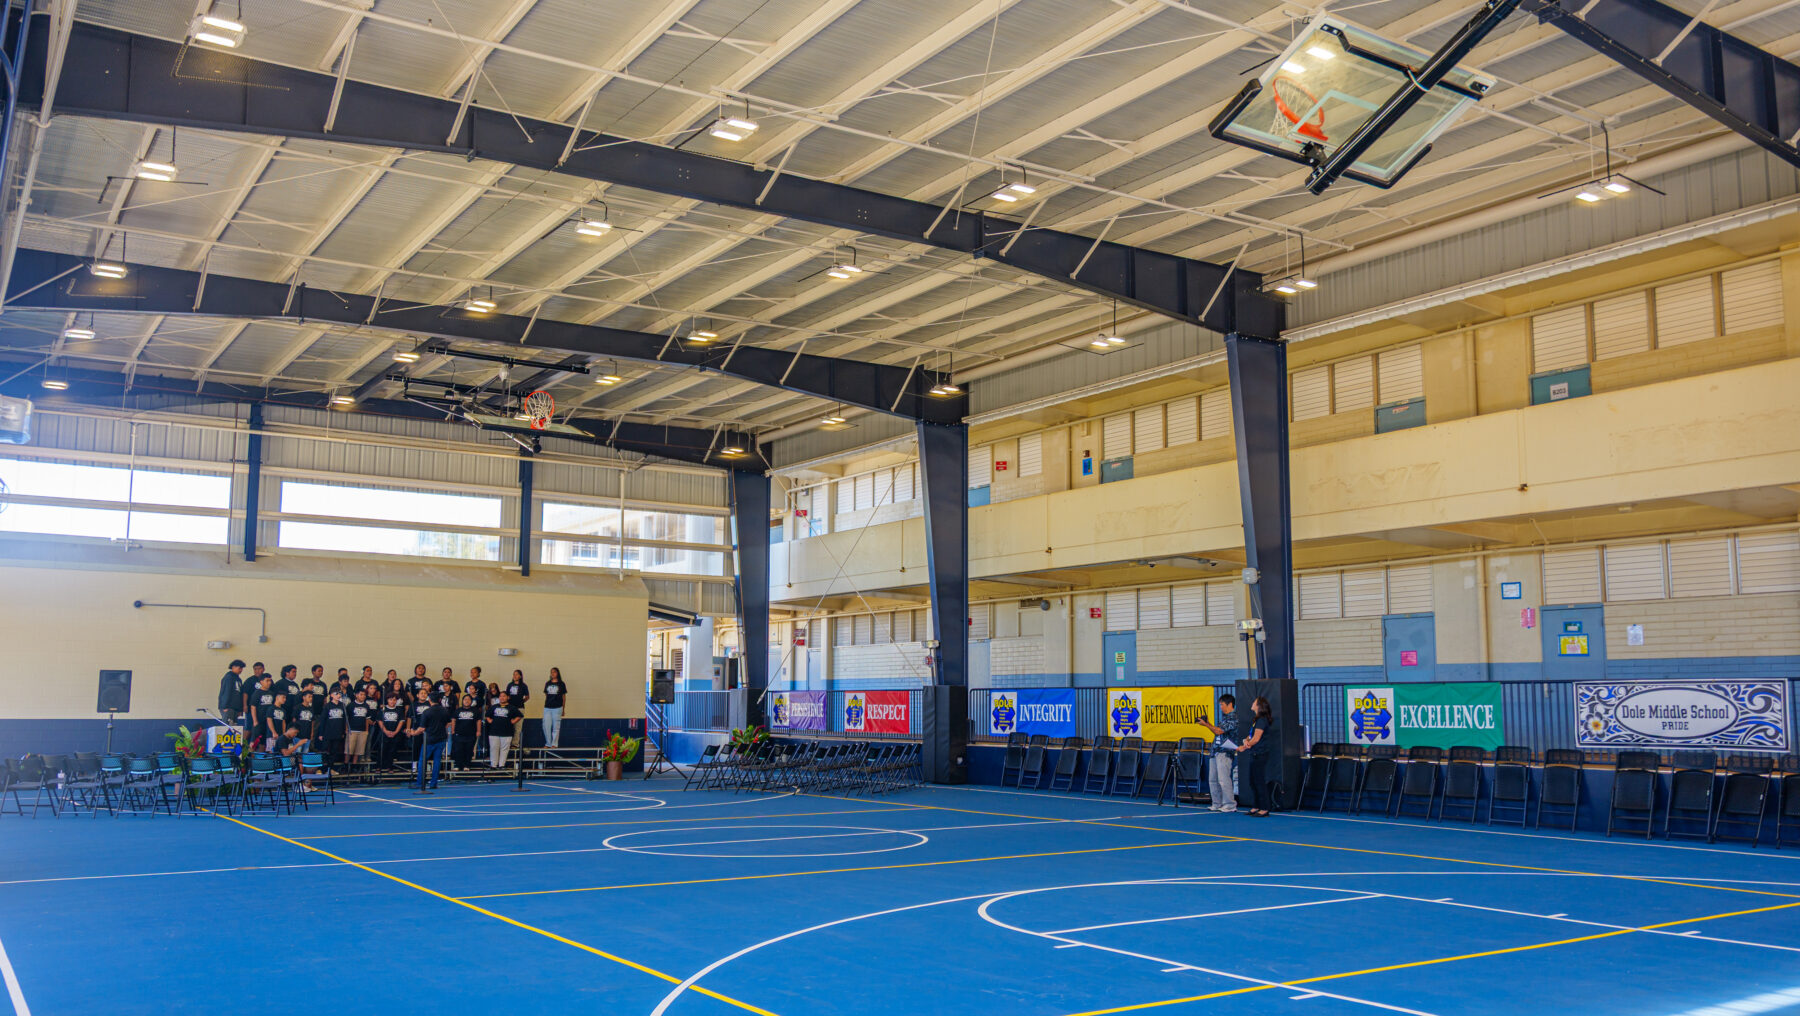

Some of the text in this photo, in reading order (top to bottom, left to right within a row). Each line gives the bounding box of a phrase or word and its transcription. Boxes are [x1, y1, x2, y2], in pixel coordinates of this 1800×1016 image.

[994, 699, 1013, 708] DOLE
[1114, 699, 1136, 708] DOLE
[1354, 698, 1387, 709] DOLE
[866, 704, 906, 720] RESPECT
[1019, 704, 1072, 722] INTEGRITY
[1400, 704, 1495, 729] EXCELLENCE
[1622, 705, 1729, 719] Dole Middle School
[1661, 721, 1689, 731] PRIDE
[216, 735, 241, 744] DOLE
